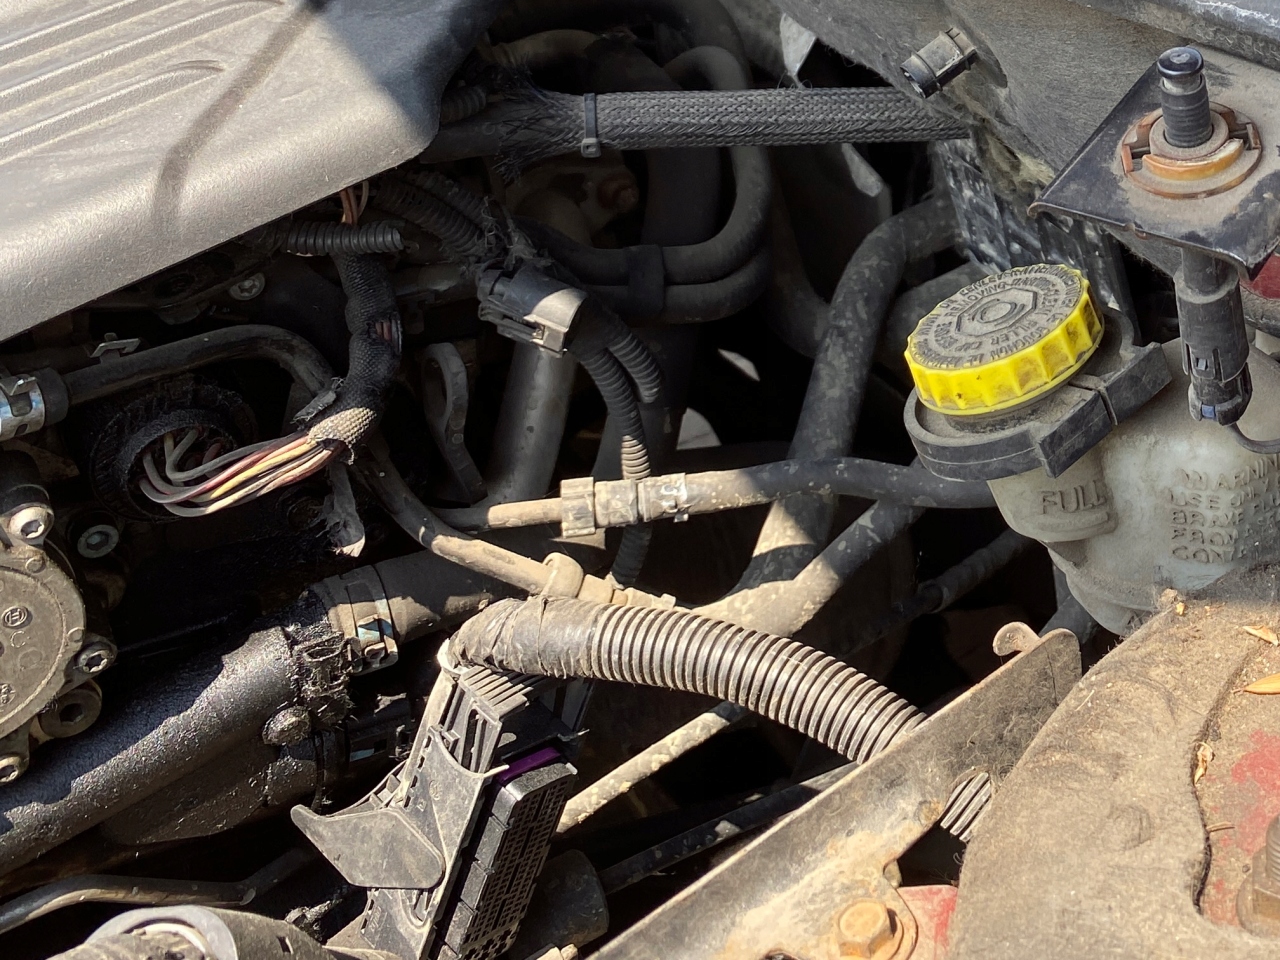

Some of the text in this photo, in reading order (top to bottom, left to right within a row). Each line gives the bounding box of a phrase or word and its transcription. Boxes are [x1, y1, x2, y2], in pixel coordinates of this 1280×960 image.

[945, 281, 1006, 317] REMOVING
[1040, 480, 1107, 514] FULL
[1167, 488, 1221, 510] USE
[1230, 478, 1270, 507] ONLY
[1171, 508, 1245, 528] BRAKE
[1171, 527, 1239, 547] FROM
